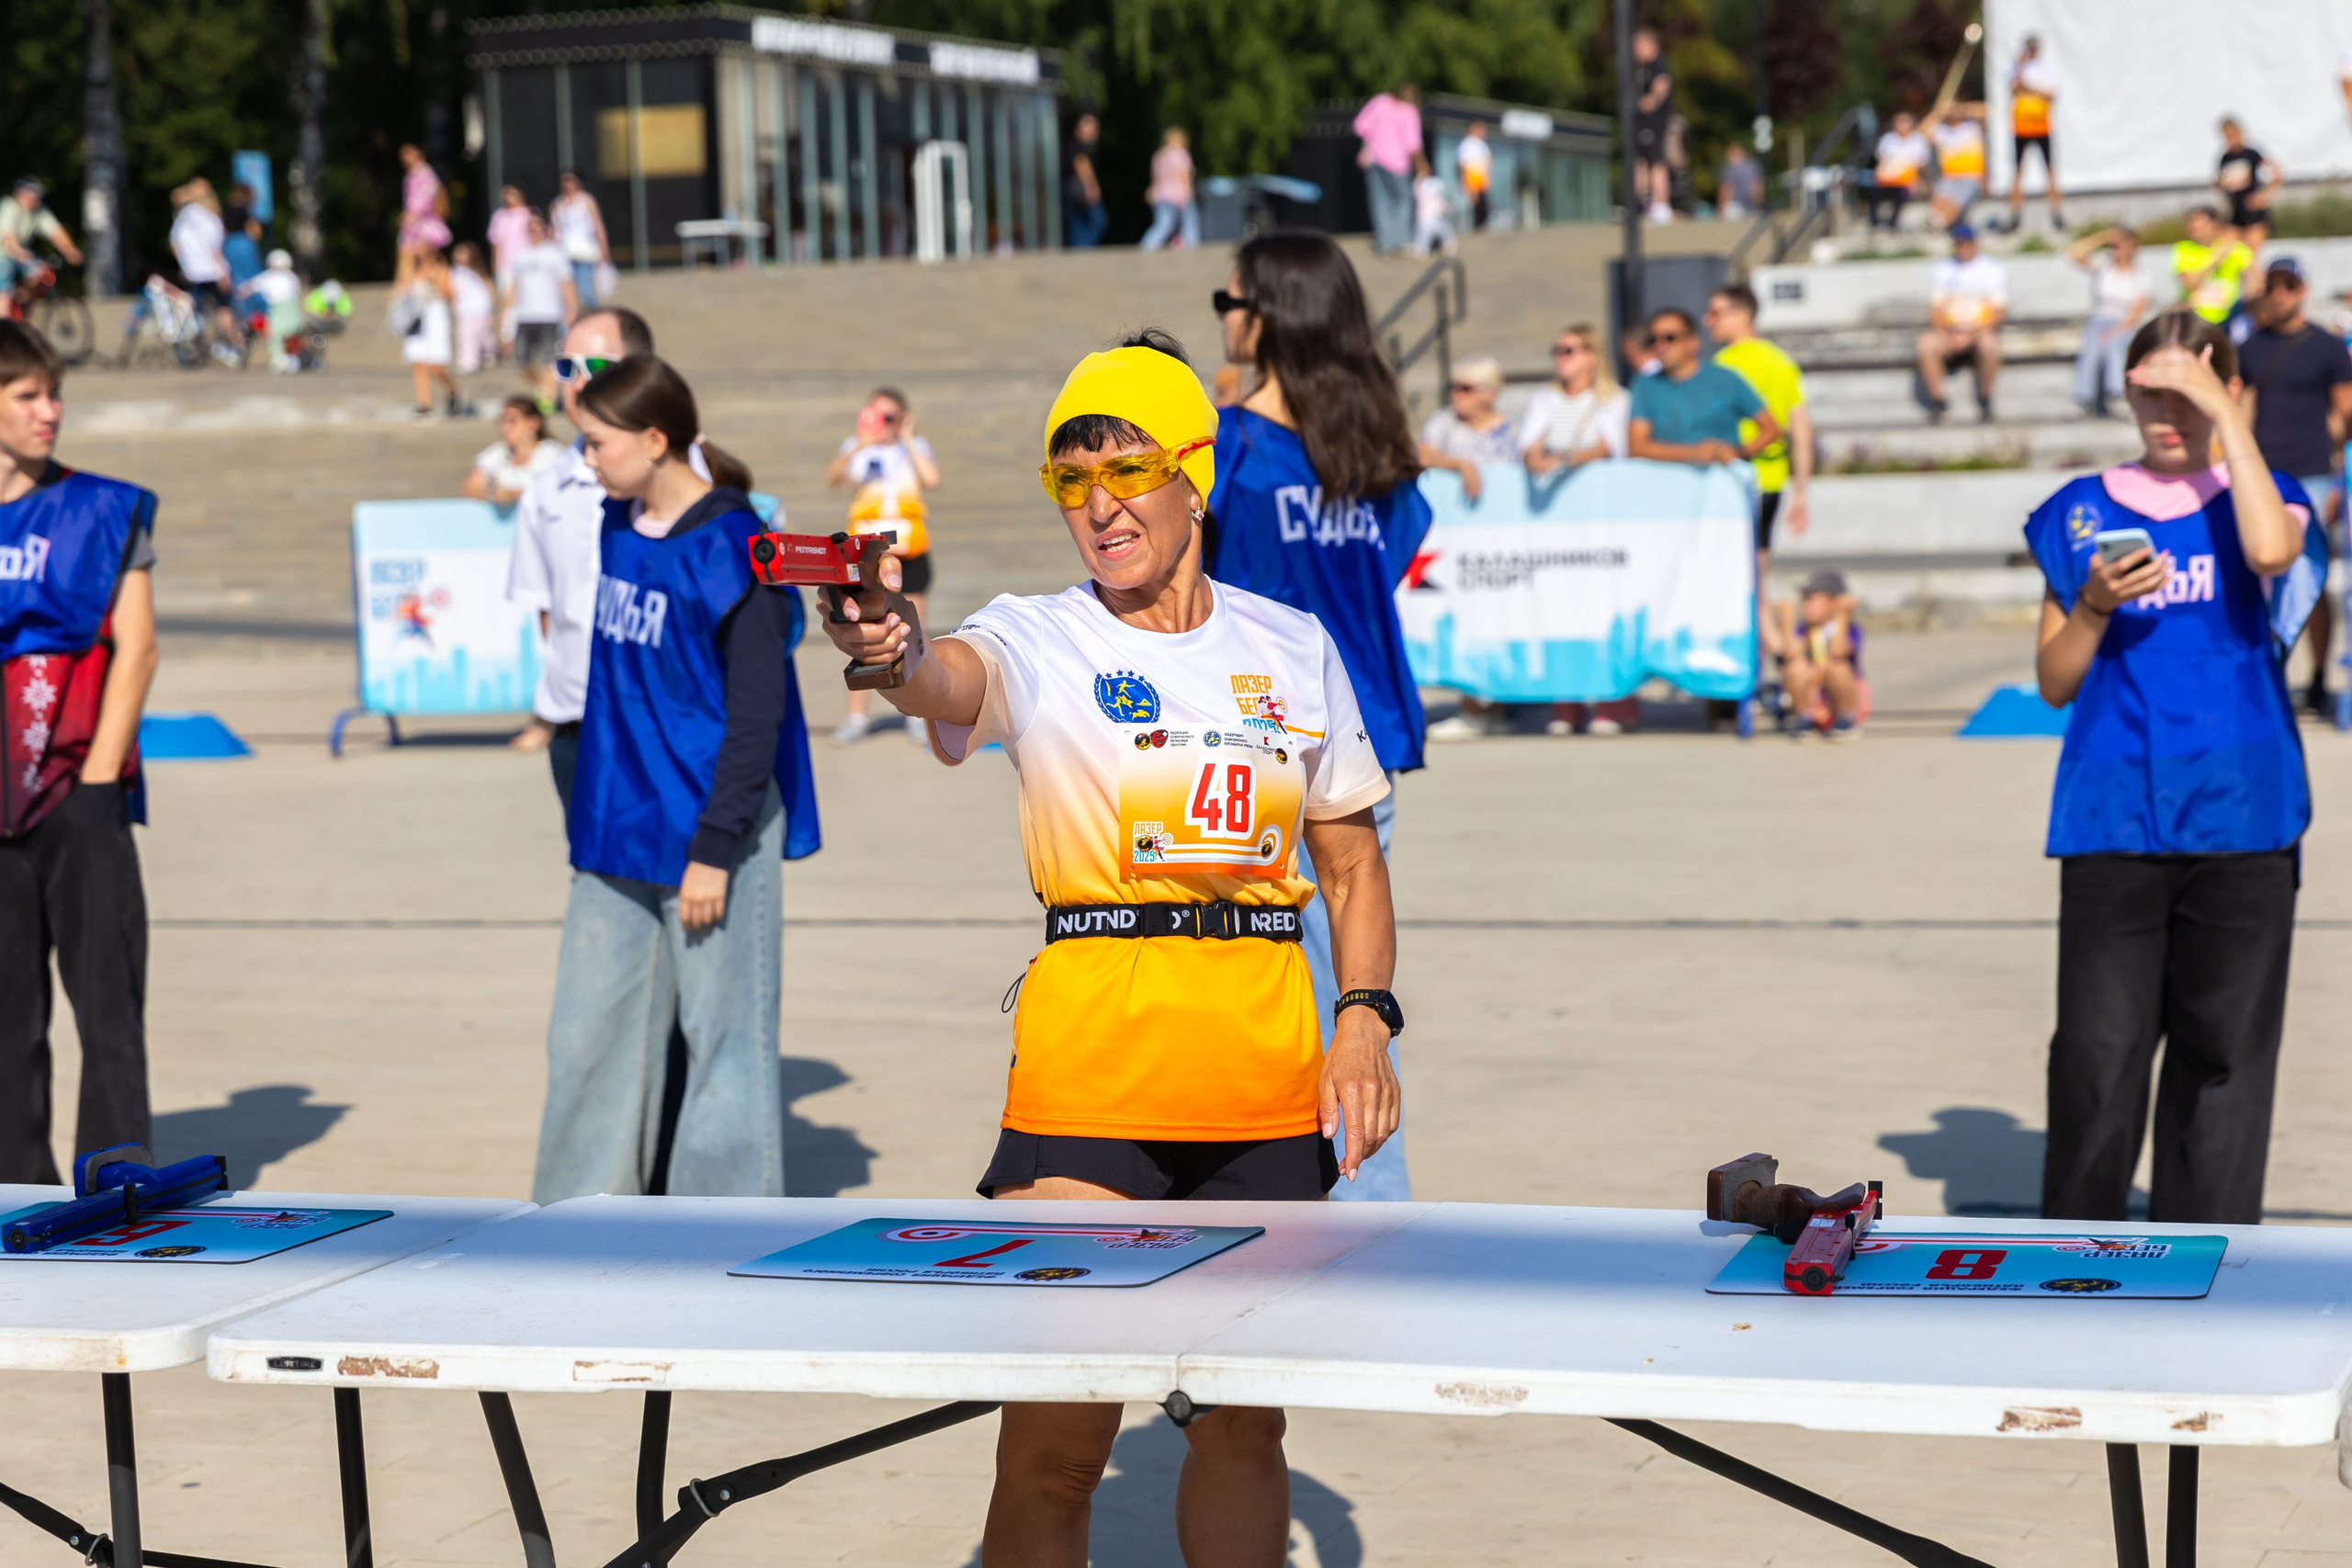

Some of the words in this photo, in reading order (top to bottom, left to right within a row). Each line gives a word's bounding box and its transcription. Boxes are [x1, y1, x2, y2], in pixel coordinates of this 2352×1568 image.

[1230, 674, 1272, 695] ЛАЗЕР
[1192, 763, 1251, 833] 48
[1135, 823, 1162, 835] ЛАЗЕР
[1134, 851, 1155, 863] 2025
[70, 1220, 192, 1247] 6
[931, 1239, 1036, 1269] 7
[1924, 1248, 2009, 1280] 8
